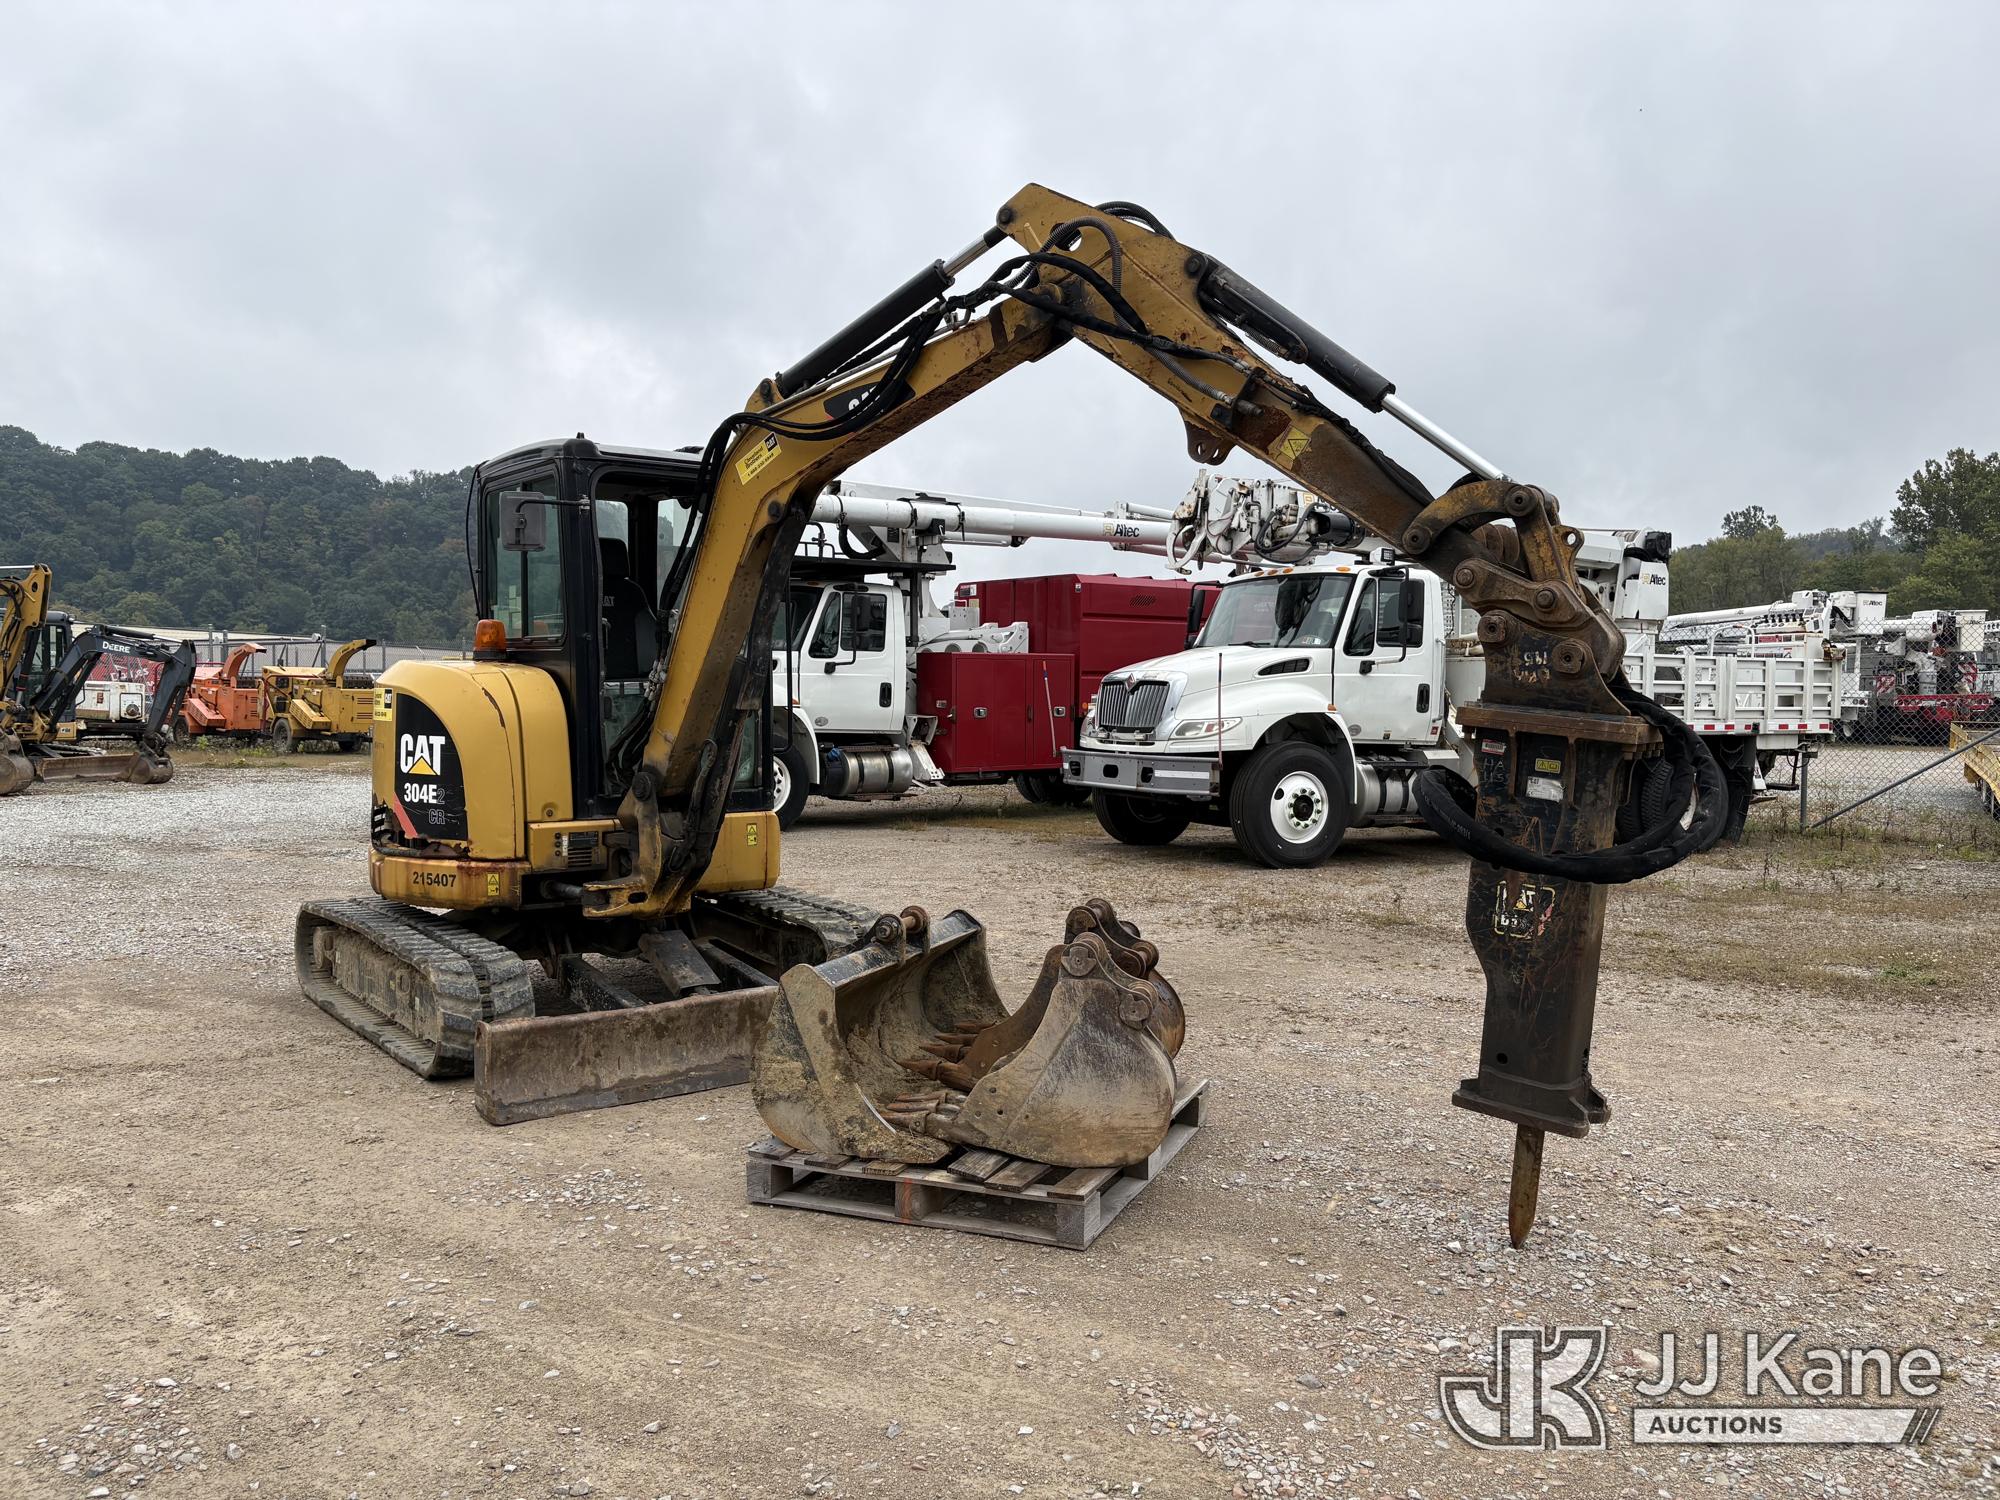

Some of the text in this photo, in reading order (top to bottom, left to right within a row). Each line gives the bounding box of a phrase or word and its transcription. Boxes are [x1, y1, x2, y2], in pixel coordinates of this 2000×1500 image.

[1113, 523, 1140, 538] Altec
[1650, 573, 1666, 586] Altec
[602, 595, 615, 607] AT
[102, 640, 131, 654] DEERE
[400, 733, 446, 776] CAT
[428, 808, 446, 825] CR
[412, 871, 457, 888] 215407
